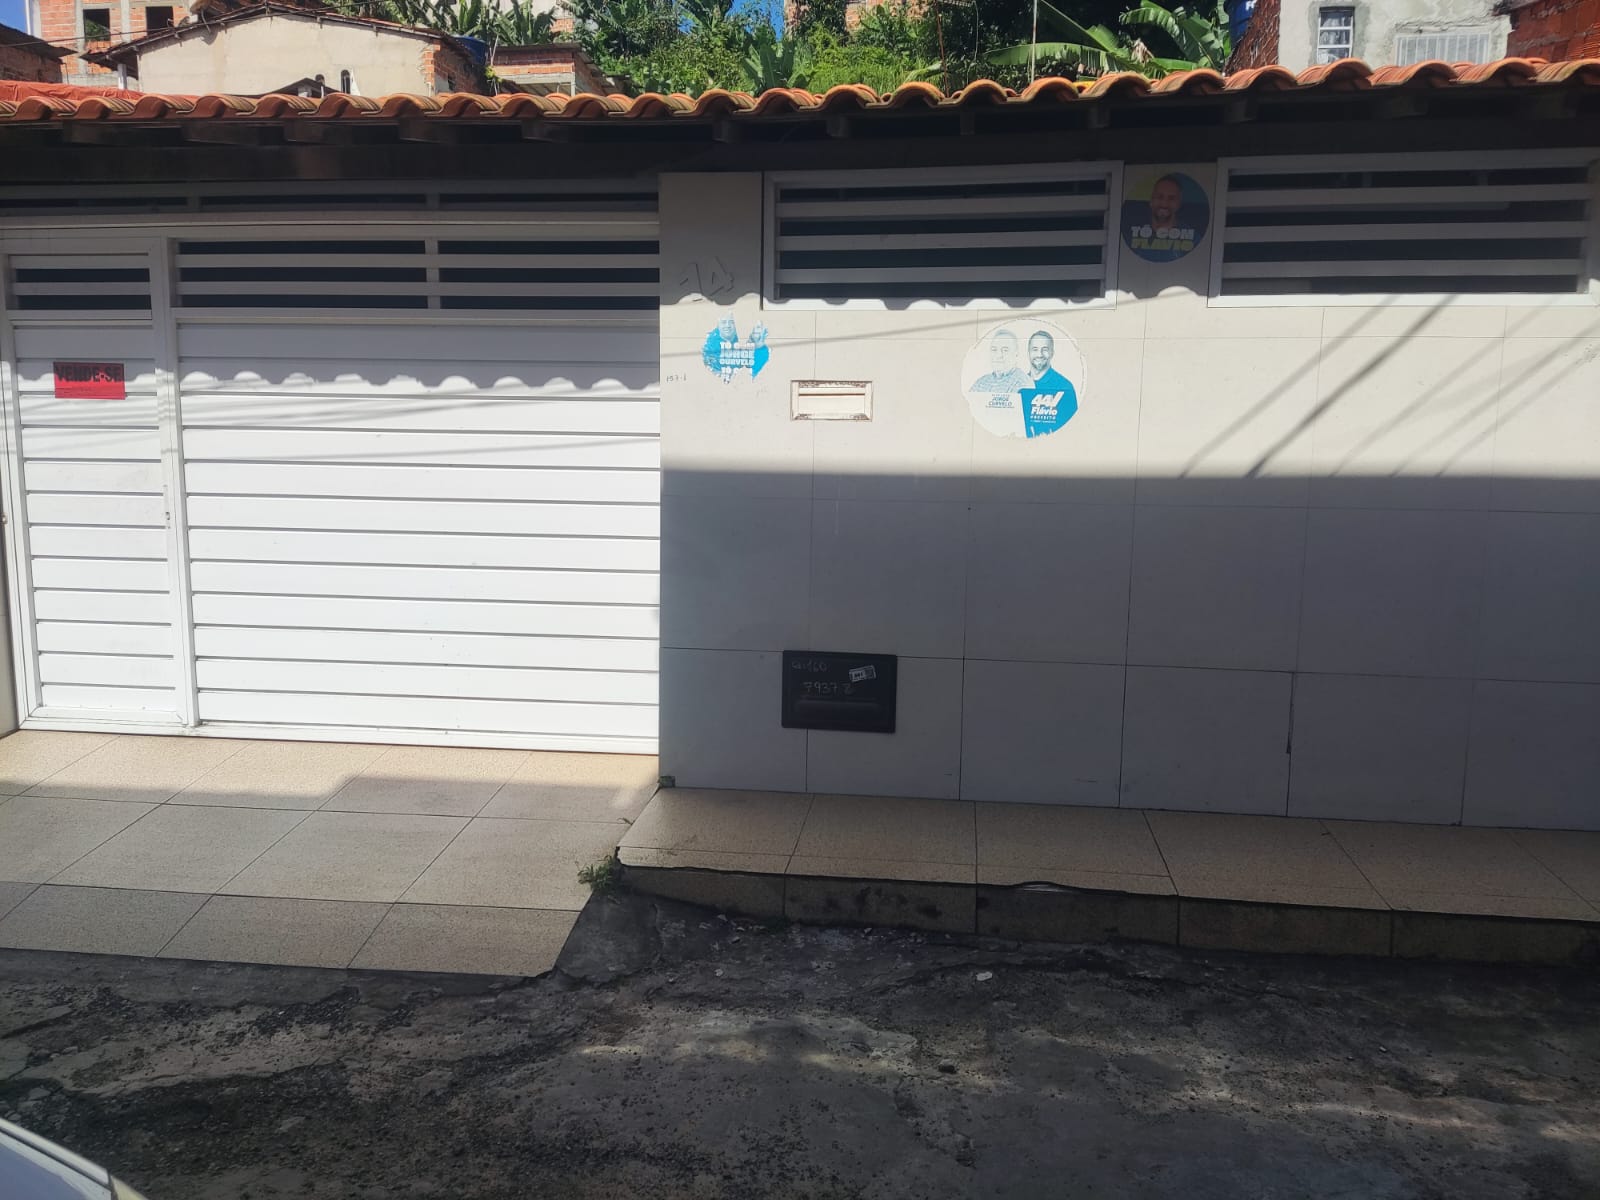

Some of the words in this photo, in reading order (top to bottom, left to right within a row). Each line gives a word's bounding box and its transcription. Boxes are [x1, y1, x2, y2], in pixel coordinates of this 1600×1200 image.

[1156, 227, 1195, 240] COM
[719, 349, 755, 359] JORGE
[719, 358, 755, 366] CURVELO
[54, 365, 123, 382] VENDE-SE
[1030, 406, 1058, 416] Flávio
